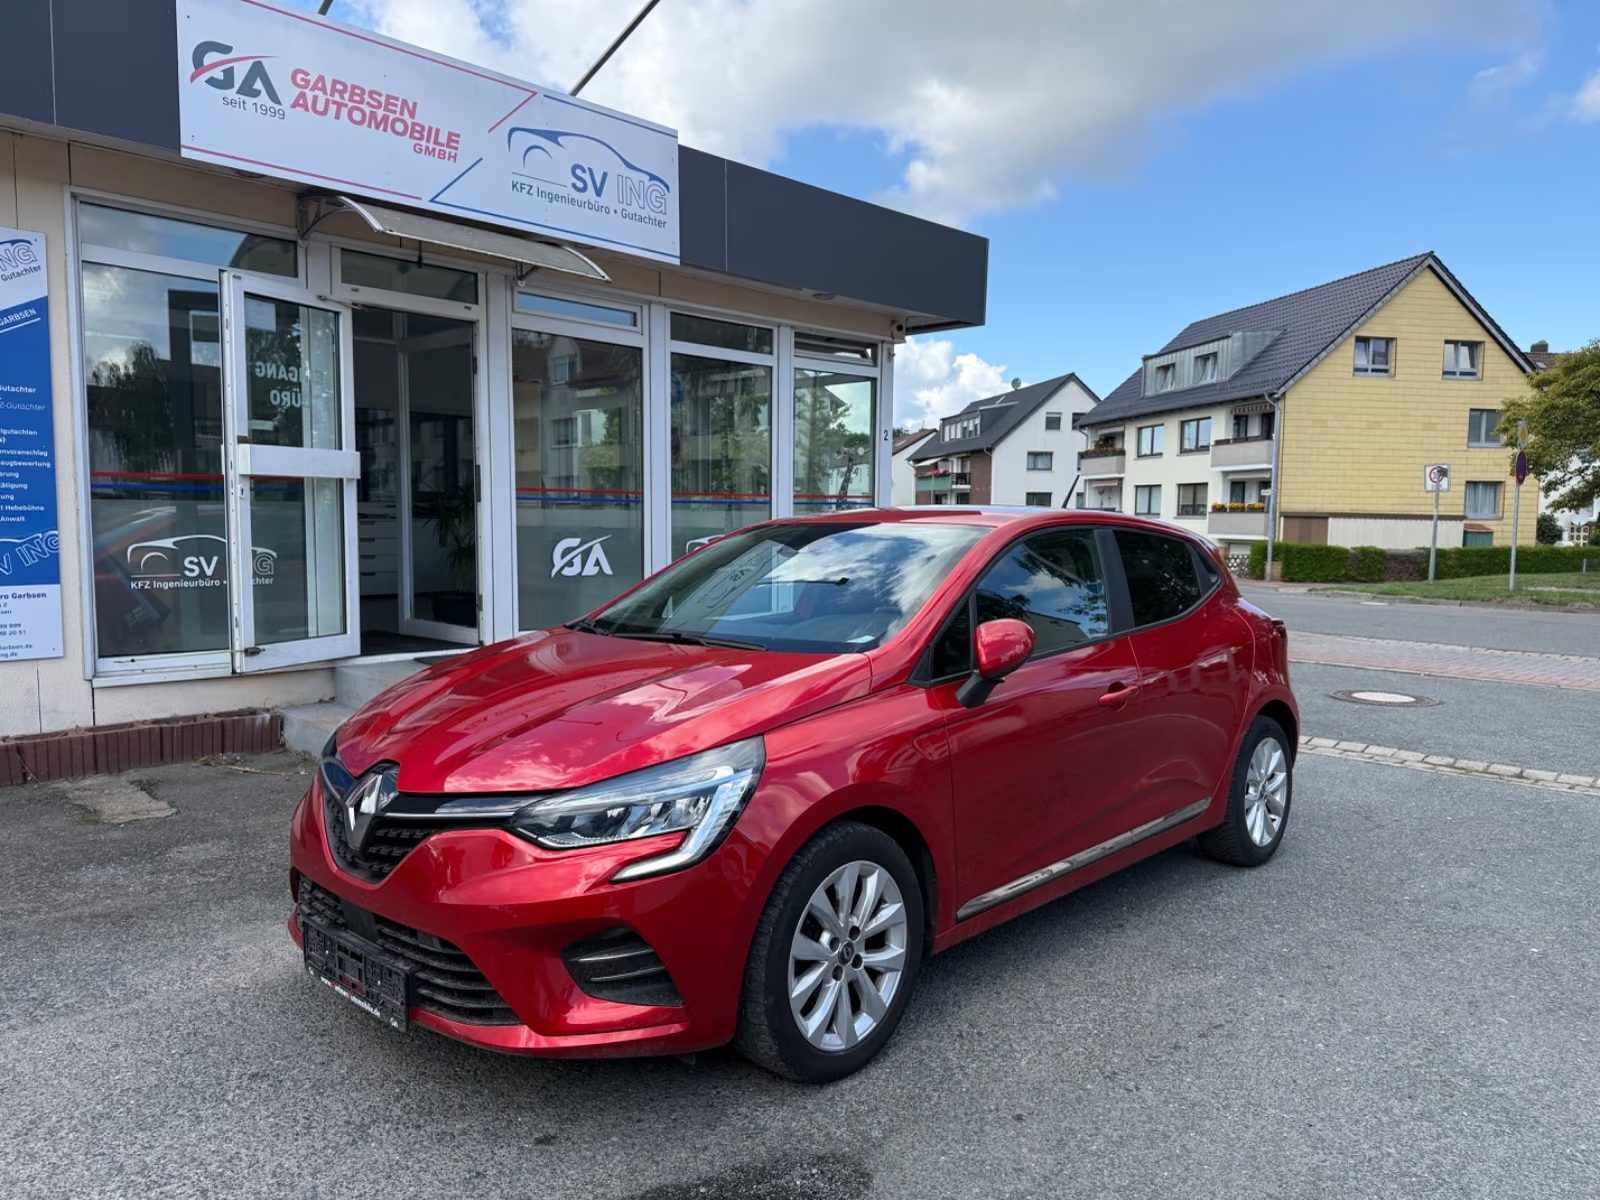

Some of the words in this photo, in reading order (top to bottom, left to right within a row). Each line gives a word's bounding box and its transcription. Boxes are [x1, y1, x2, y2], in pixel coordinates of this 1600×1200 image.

[191, 40, 282, 106] GA
[222, 96, 247, 112] seit
[252, 102, 286, 120] 1999
[290, 67, 418, 120] GARBSEN
[290, 91, 461, 151] AUTOMOBILE
[412, 142, 458, 164] GMBH
[511, 180, 534, 197] KFZ
[536, 186, 611, 216] Ingenieurbüro
[620, 208, 668, 229] Gutachter
[570, 163, 609, 198] SV
[616, 174, 668, 216] ING
[0, 265, 41, 282] Gutachter
[883, 429, 889, 441] 2
[16, 532, 59, 567] ING
[184, 556, 219, 577] SV
[552, 536, 614, 578] GA
[130, 580, 151, 590] KFZ
[153, 579, 221, 590] Ingenieurbüro
